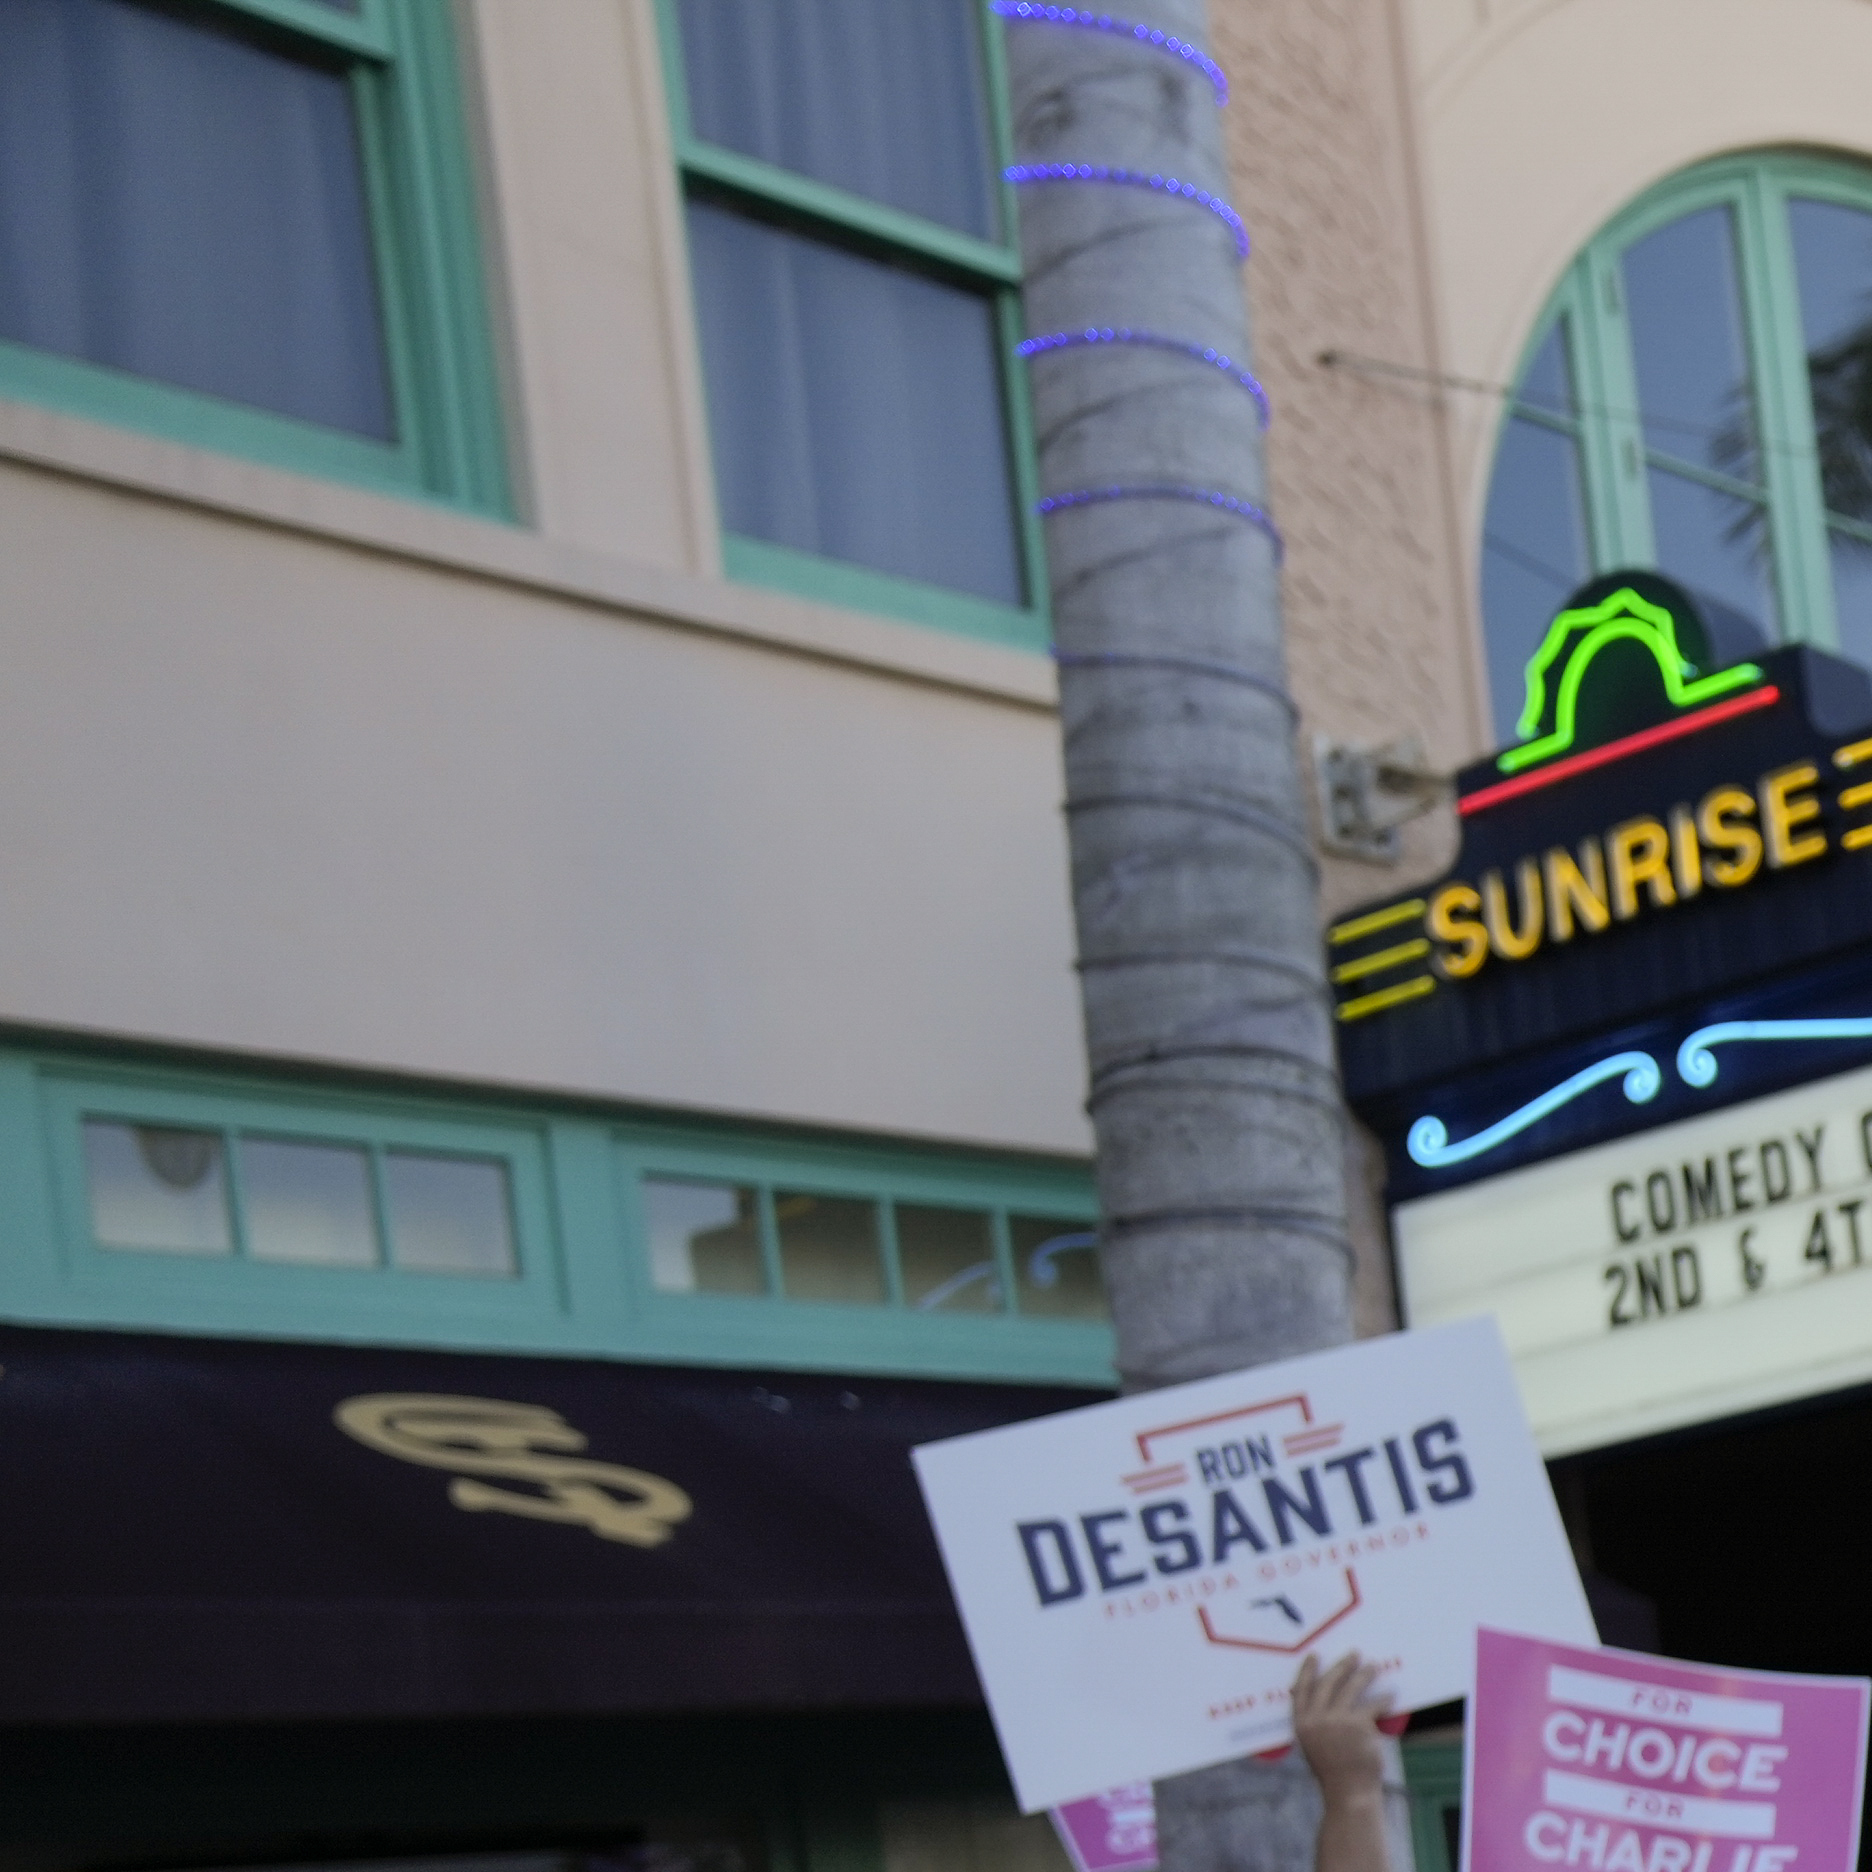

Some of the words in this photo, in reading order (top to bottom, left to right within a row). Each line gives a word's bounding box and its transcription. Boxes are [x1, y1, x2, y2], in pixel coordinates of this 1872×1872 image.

[1425, 760, 1827, 980] SUNRISE
[1609, 1121, 1827, 1243] COMEDY
[1608, 1257, 1702, 1328] 2ND
[1742, 1231, 1766, 1292] &
[1195, 1433, 1276, 1486] RON
[1016, 1418, 1475, 1608] DESANTIS
[1104, 1572, 1240, 1620] FLORIDA
[1257, 1521, 1432, 1584] GOVERNOR
[1630, 1690, 1694, 1715] FOR
[1543, 1710, 1788, 1793] CHOICE
[1623, 1793, 1685, 1819] FOR
